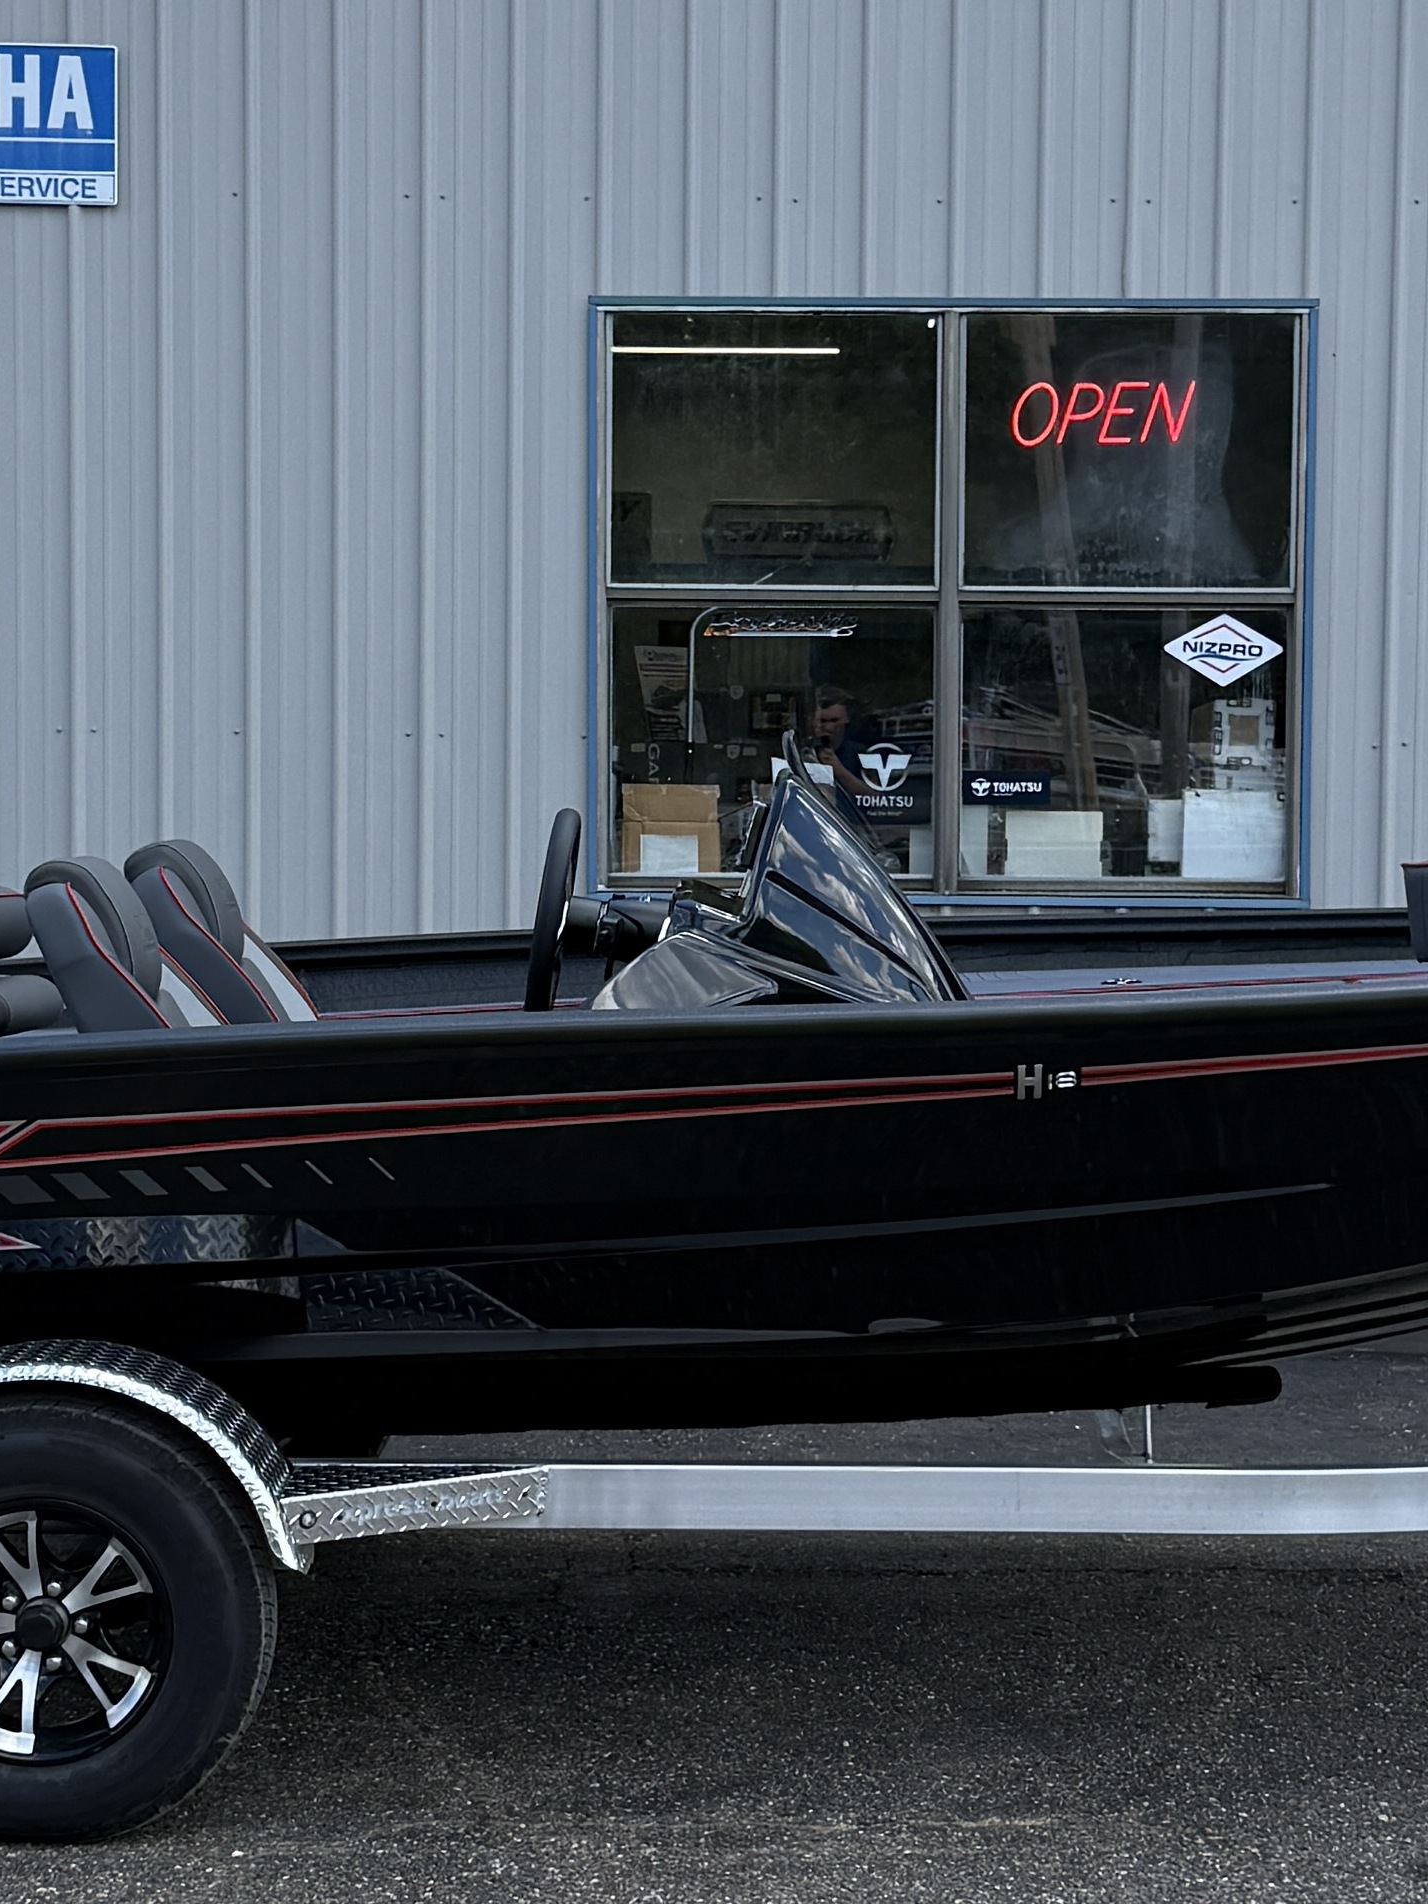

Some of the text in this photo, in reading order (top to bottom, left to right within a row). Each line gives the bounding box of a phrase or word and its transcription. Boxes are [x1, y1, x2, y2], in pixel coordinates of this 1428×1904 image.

[1010, 380, 1197, 447] OPEN
[1182, 641, 1263, 657] NIZPRO
[993, 782, 1042, 793] TOHATSU
[855, 794, 913, 808] TOHATSU
